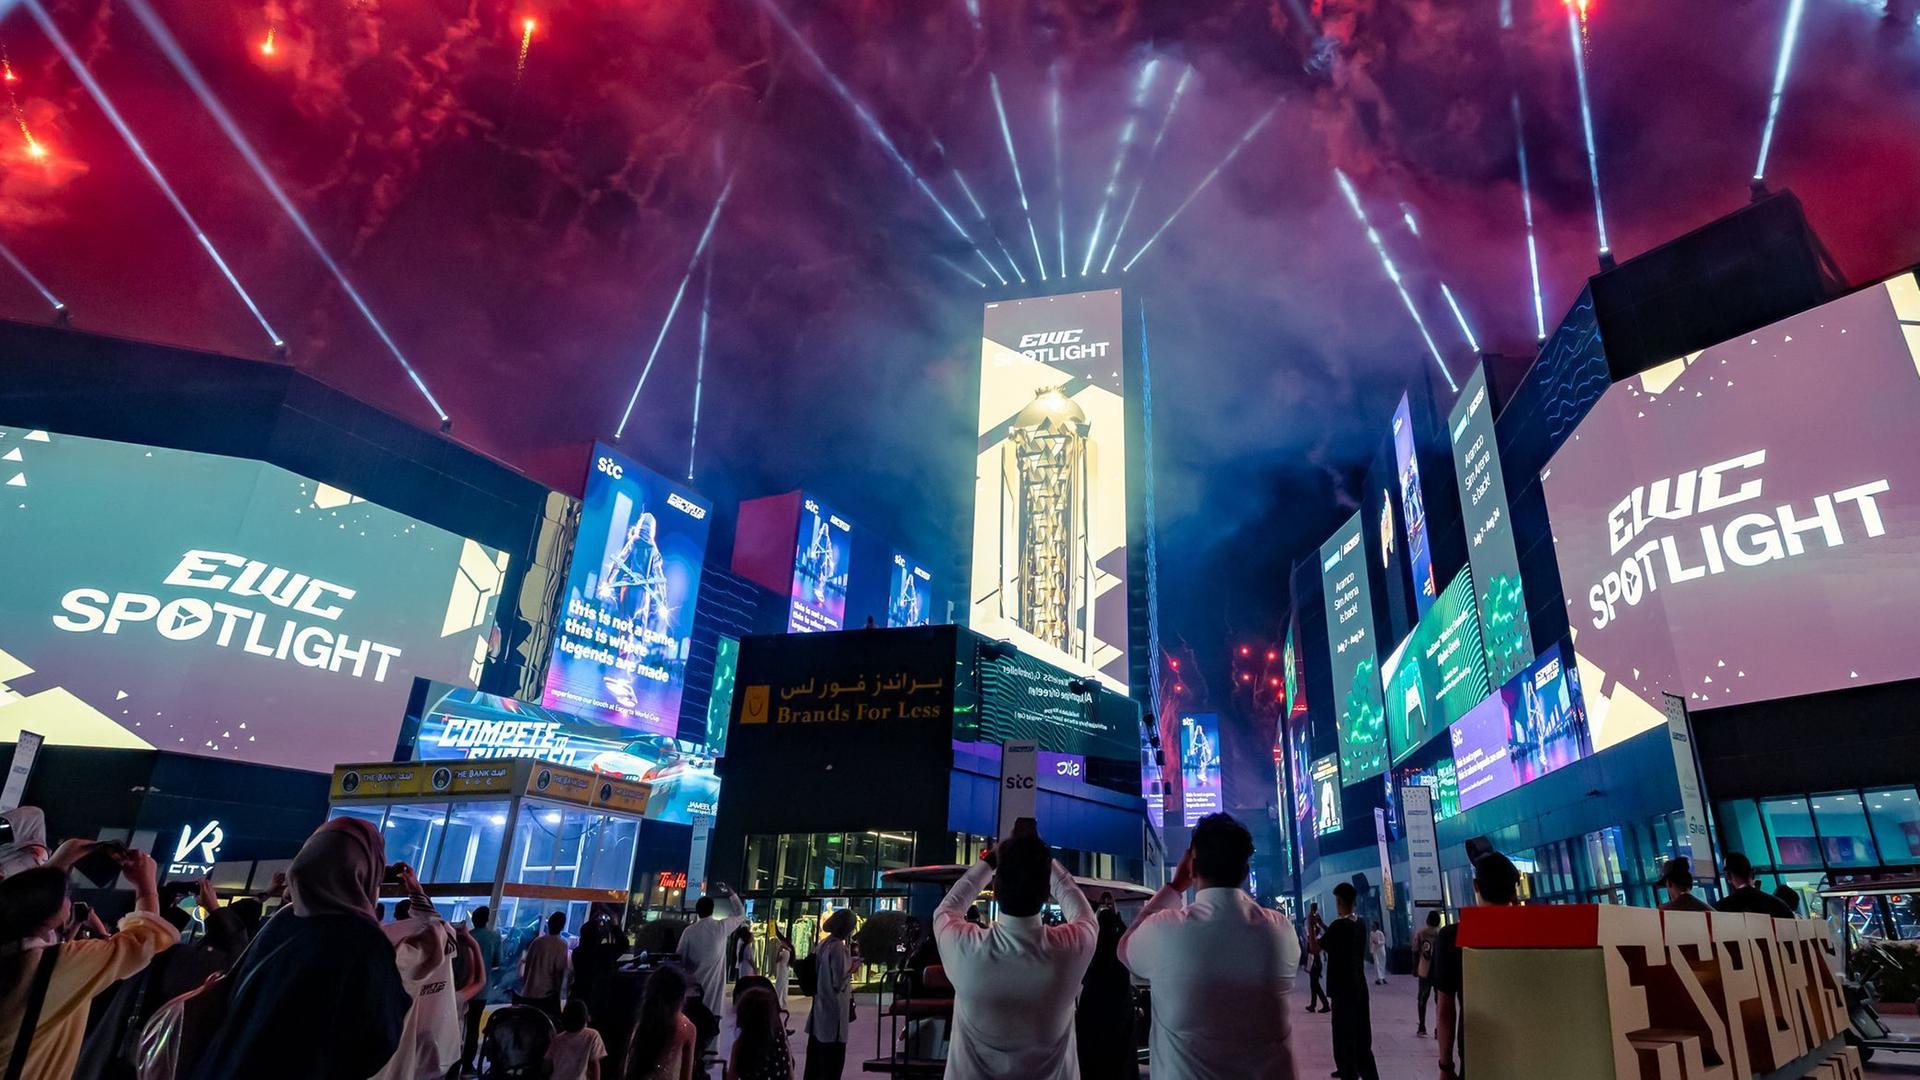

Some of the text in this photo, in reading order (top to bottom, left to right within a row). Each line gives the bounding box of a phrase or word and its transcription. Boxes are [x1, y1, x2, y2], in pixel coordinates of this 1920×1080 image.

[1019, 329, 1084, 348] EWC
[597, 456, 624, 480] stc
[1608, 449, 1766, 556] EWC
[1589, 479, 1890, 630] SPOTLIGHT
[163, 549, 356, 620] EWC
[565, 617, 593, 639] this
[595, 627, 608, 644] is
[569, 599, 597, 620] this
[599, 608, 611, 626] is
[612, 616, 634, 633] not
[634, 625, 643, 636] a
[52, 588, 402, 683] SPOTLIGHT
[560, 635, 615, 666] legends
[637, 663, 670, 683] made
[780, 672, 943, 700] براندز فور لس
[776, 701, 941, 723] Brands For Less
[437, 719, 562, 748] COMPETE
[469, 768, 489, 777] BANK
[1006, 774, 1034, 789] stc
[173, 819, 226, 865] VR
[168, 862, 214, 876] CITY
[660, 872, 674, 888] Tim
